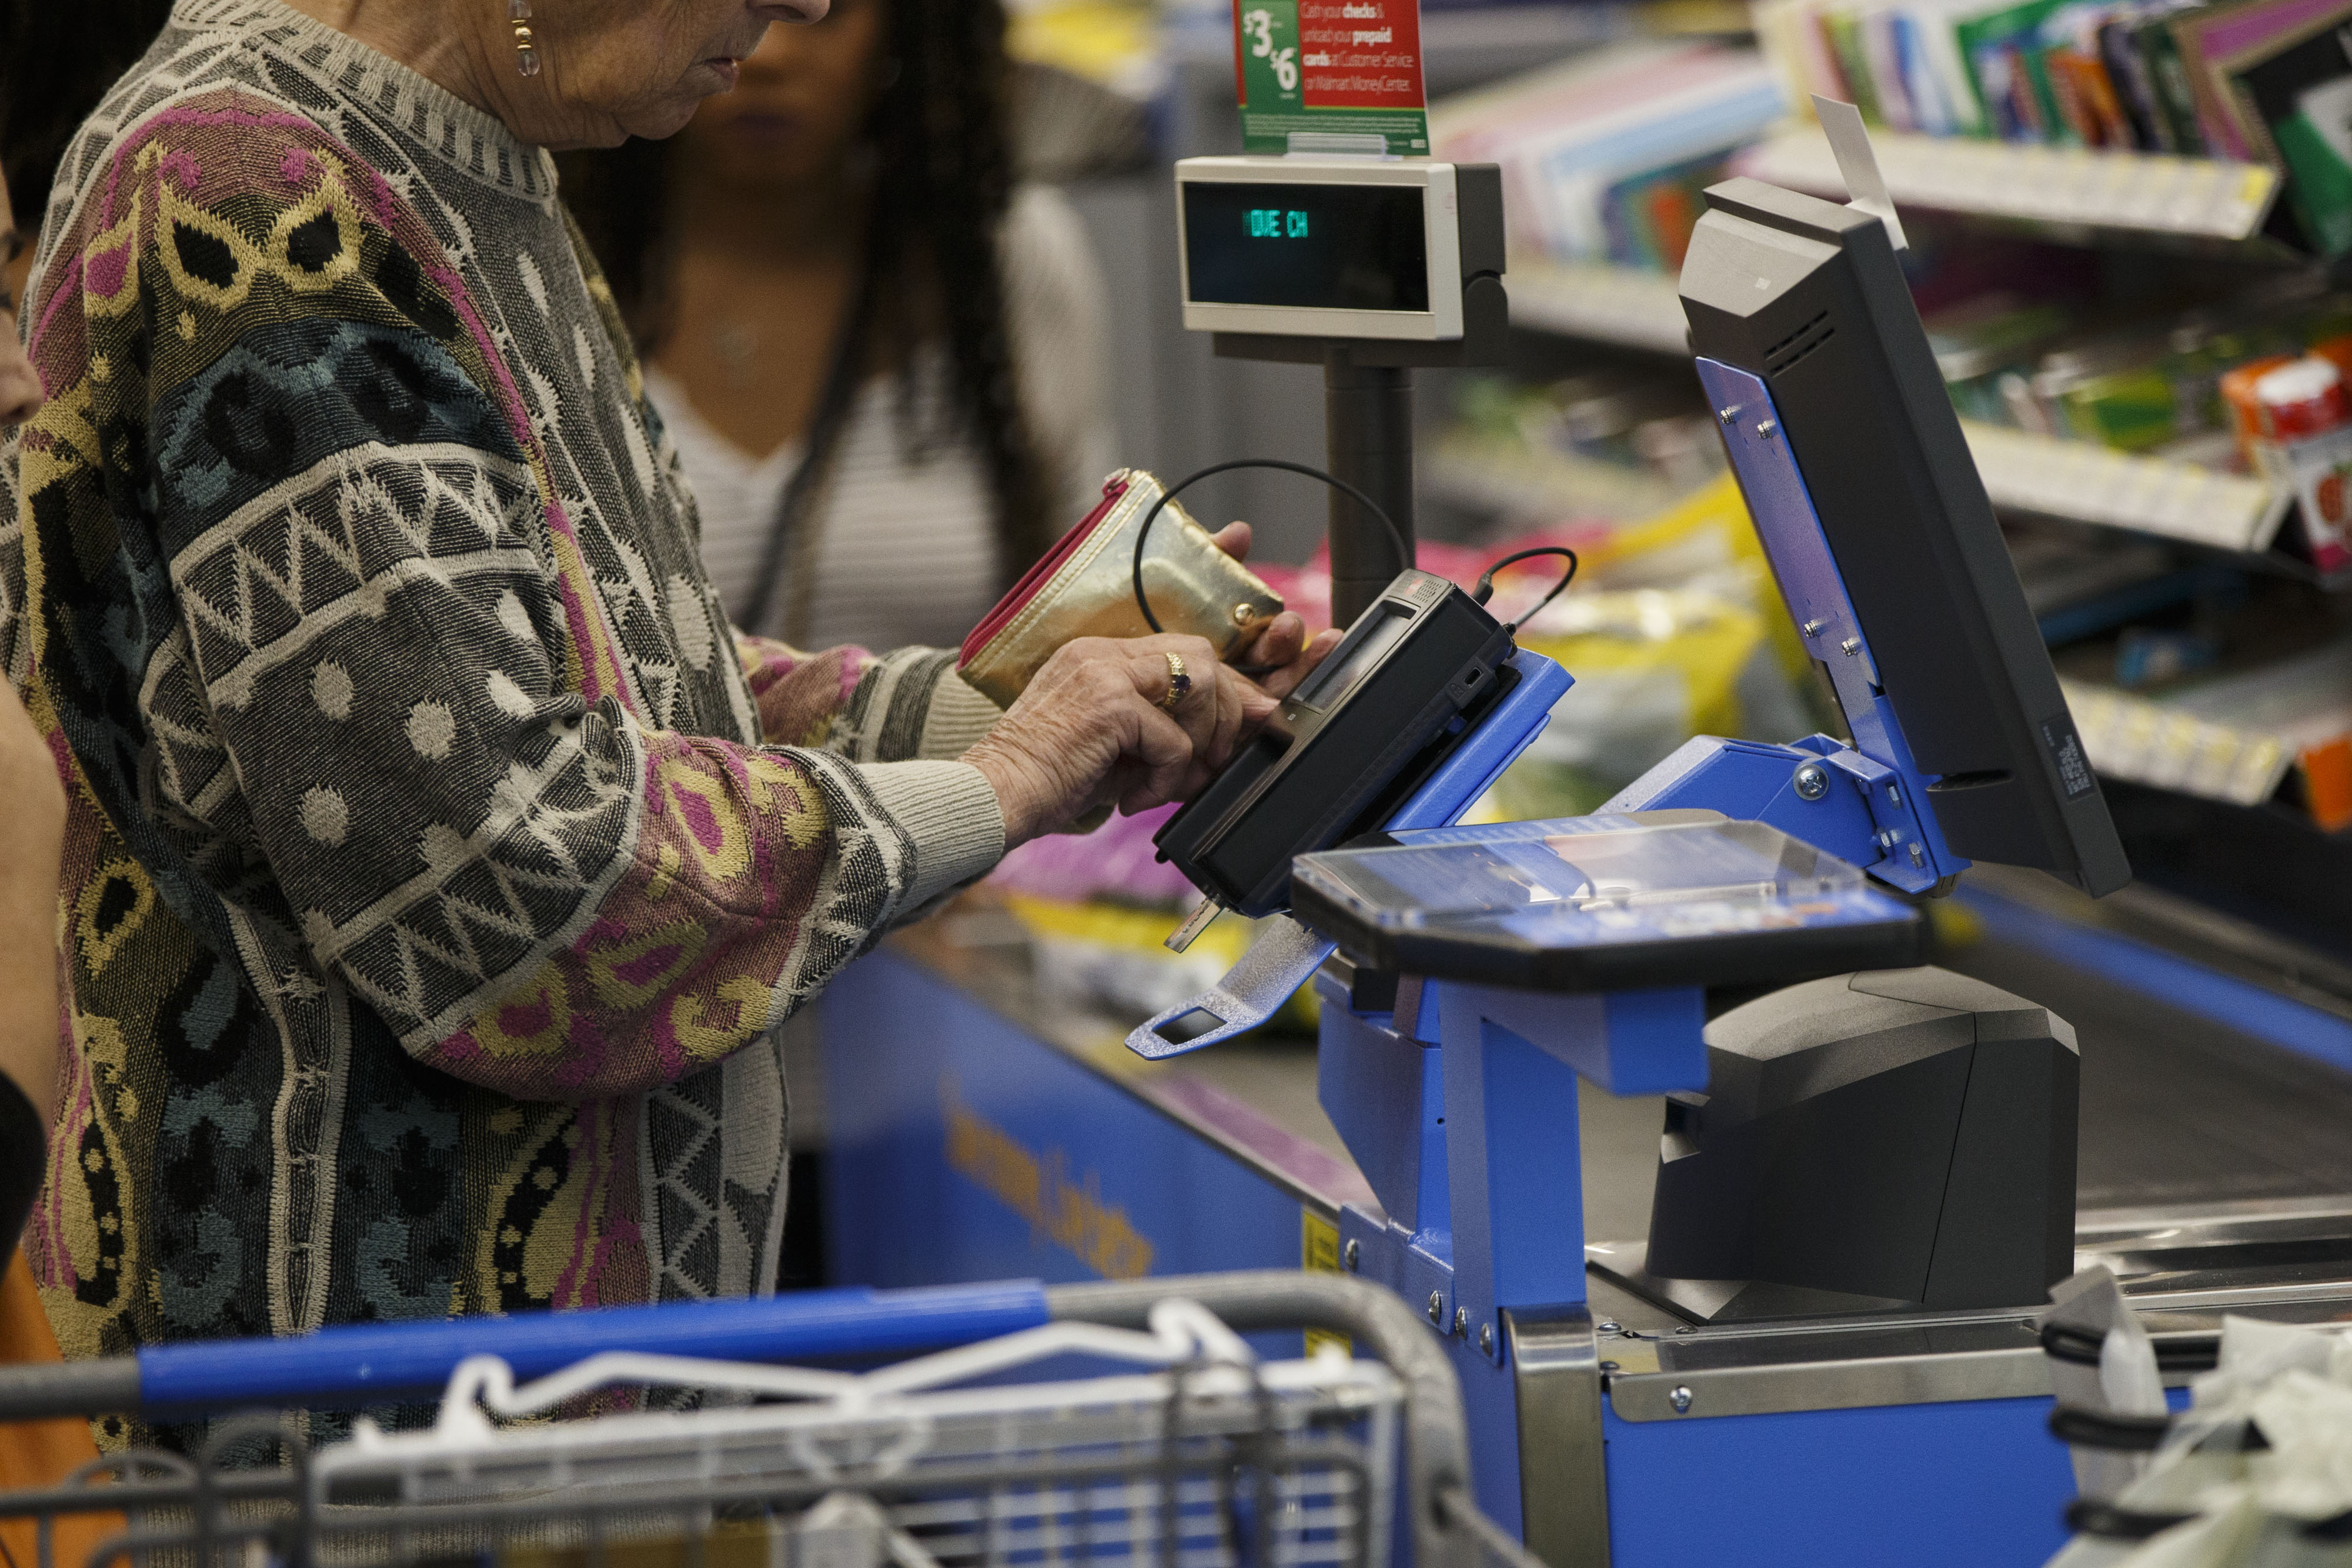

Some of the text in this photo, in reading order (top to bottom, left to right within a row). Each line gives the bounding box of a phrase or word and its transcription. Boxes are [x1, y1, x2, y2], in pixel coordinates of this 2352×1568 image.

[1342, 2, 1377, 19] checks
[1244, 9, 1272, 58] $3
[1352, 26, 1392, 46] prepaid
[1302, 49, 1330, 67] cards
[1338, 50, 1381, 68] Customer
[1381, 51, 1414, 68] Service
[1269, 47, 1297, 91] $6
